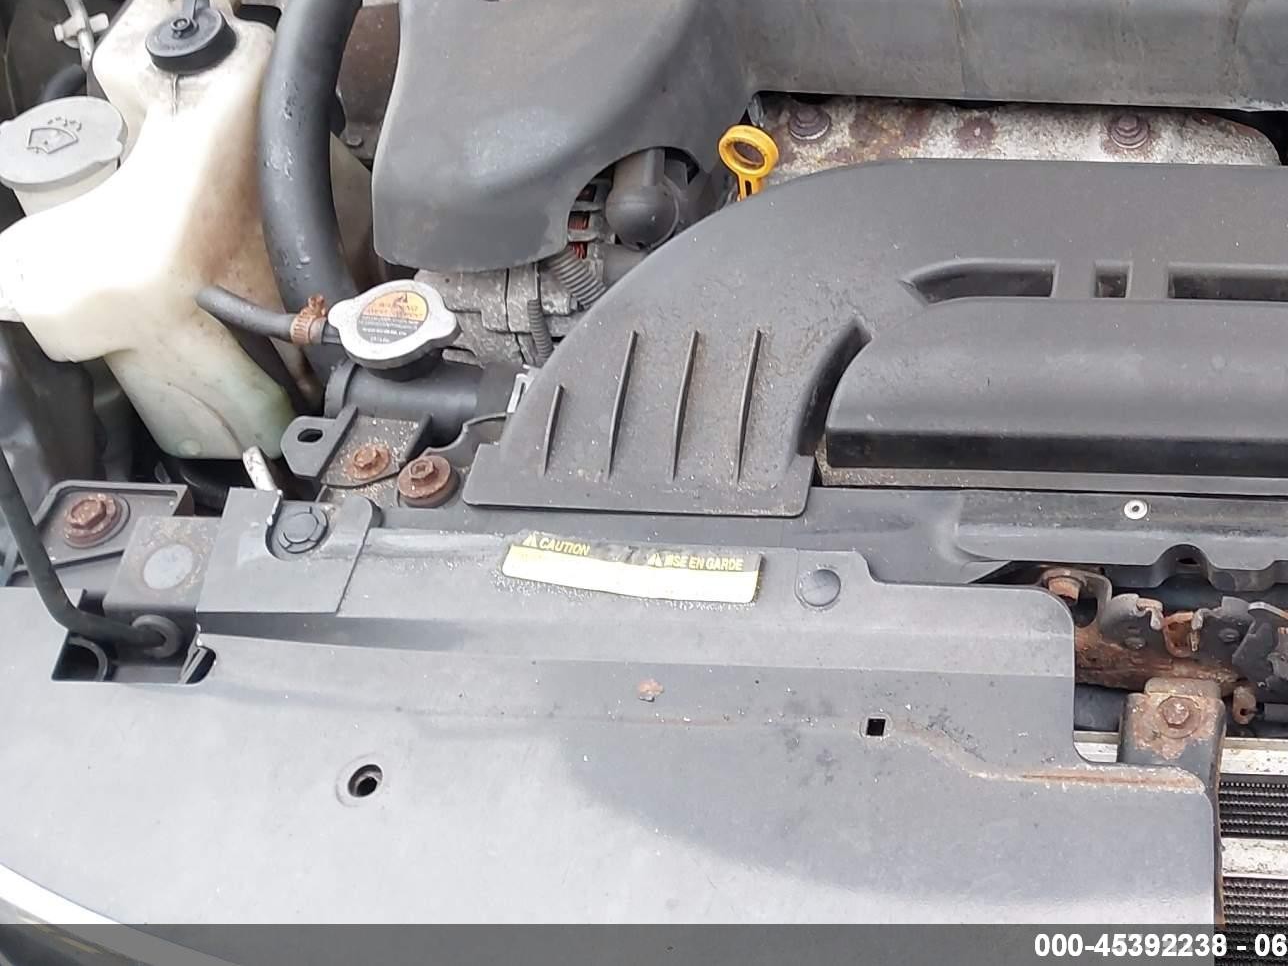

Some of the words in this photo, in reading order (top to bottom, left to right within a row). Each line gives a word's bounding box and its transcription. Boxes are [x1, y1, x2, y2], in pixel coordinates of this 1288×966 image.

[539, 540, 591, 556] CAUTION
[688, 556, 705, 570] EN
[705, 557, 744, 571] GARDE
